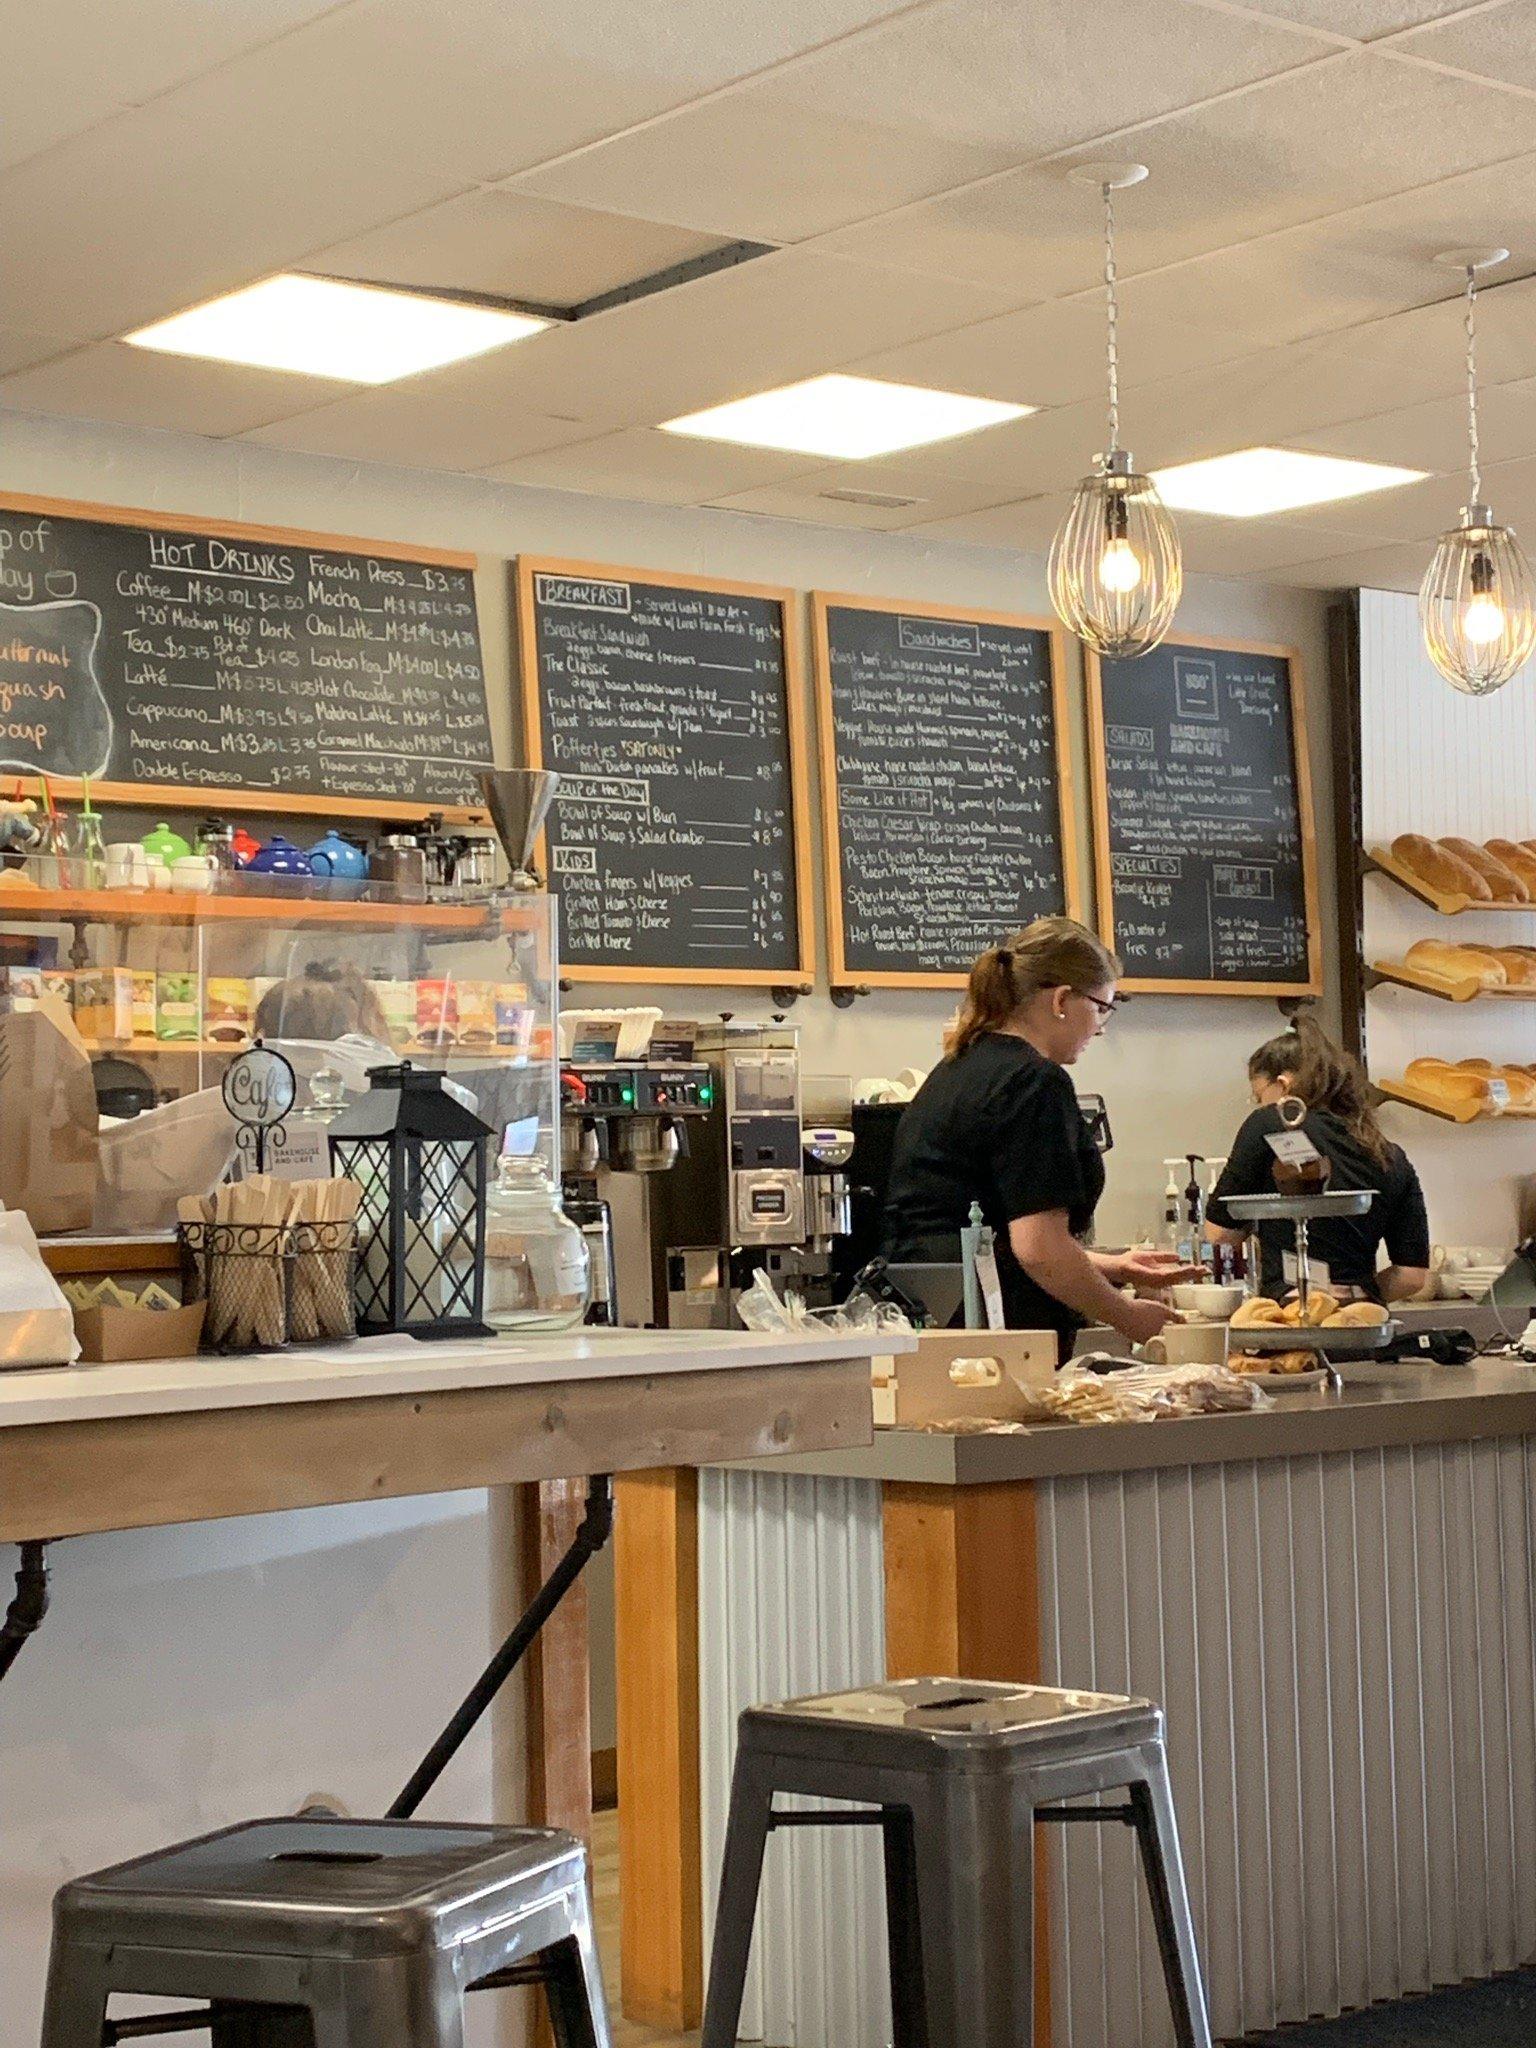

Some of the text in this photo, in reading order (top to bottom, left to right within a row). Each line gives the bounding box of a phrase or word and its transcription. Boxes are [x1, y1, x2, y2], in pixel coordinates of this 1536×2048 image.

[20, 520, 52, 553] of
[150, 533, 295, 581] HOT DRINKS
[309, 555, 406, 586] French Press
[116, 570, 172, 598] Coffee
[308, 581, 361, 611] Mocha
[546, 579, 624, 606] BREAKFAST
[172, 608, 219, 632] Medium
[259, 618, 296, 641] Dark
[306, 613, 336, 637] Chai
[543, 617, 650, 646] Breakfast Sandwich
[122, 628, 154, 654] Tea
[902, 624, 972, 650] Sandwiches
[214, 651, 242, 667] Tea
[310, 647, 383, 684] London Fog
[543, 653, 610, 675] The Classic
[313, 677, 340, 698] Hot
[343, 679, 395, 704] Chocolate
[547, 689, 575, 709] Fruit
[126, 697, 208, 723] Cappuccino
[314, 701, 359, 722] Matcha
[548, 711, 579, 728] Toast
[316, 729, 364, 750] Caramel
[1110, 728, 1150, 747] SALADS
[133, 758, 180, 780] Double
[182, 761, 242, 783] Espresso
[586, 782, 598, 796] of
[601, 784, 620, 796] the
[620, 782, 645, 802] Day
[841, 788, 871, 806] Some
[873, 790, 895, 806] Like
[910, 790, 928, 808] Hot
[557, 801, 588, 820] Bowl
[590, 804, 603, 820] of
[604, 804, 632, 823] Soup
[653, 806, 677, 824] Bun
[842, 813, 880, 829] Chicken
[880, 813, 914, 831] Caesar
[560, 823, 585, 841] Bowl
[601, 824, 626, 844] Soup
[637, 826, 667, 845] Salad
[668, 828, 705, 846] Combo
[844, 845, 877, 870] Pesto
[877, 848, 917, 865] Chicken
[562, 868, 637, 897] Chicken fingers
[565, 893, 668, 912] Grilled Ham Cheese
[567, 911, 671, 930] Grilled Tomato Cheese
[568, 932, 633, 951] Grilled Cheese
[850, 924, 915, 943] Hot Roast Beef
